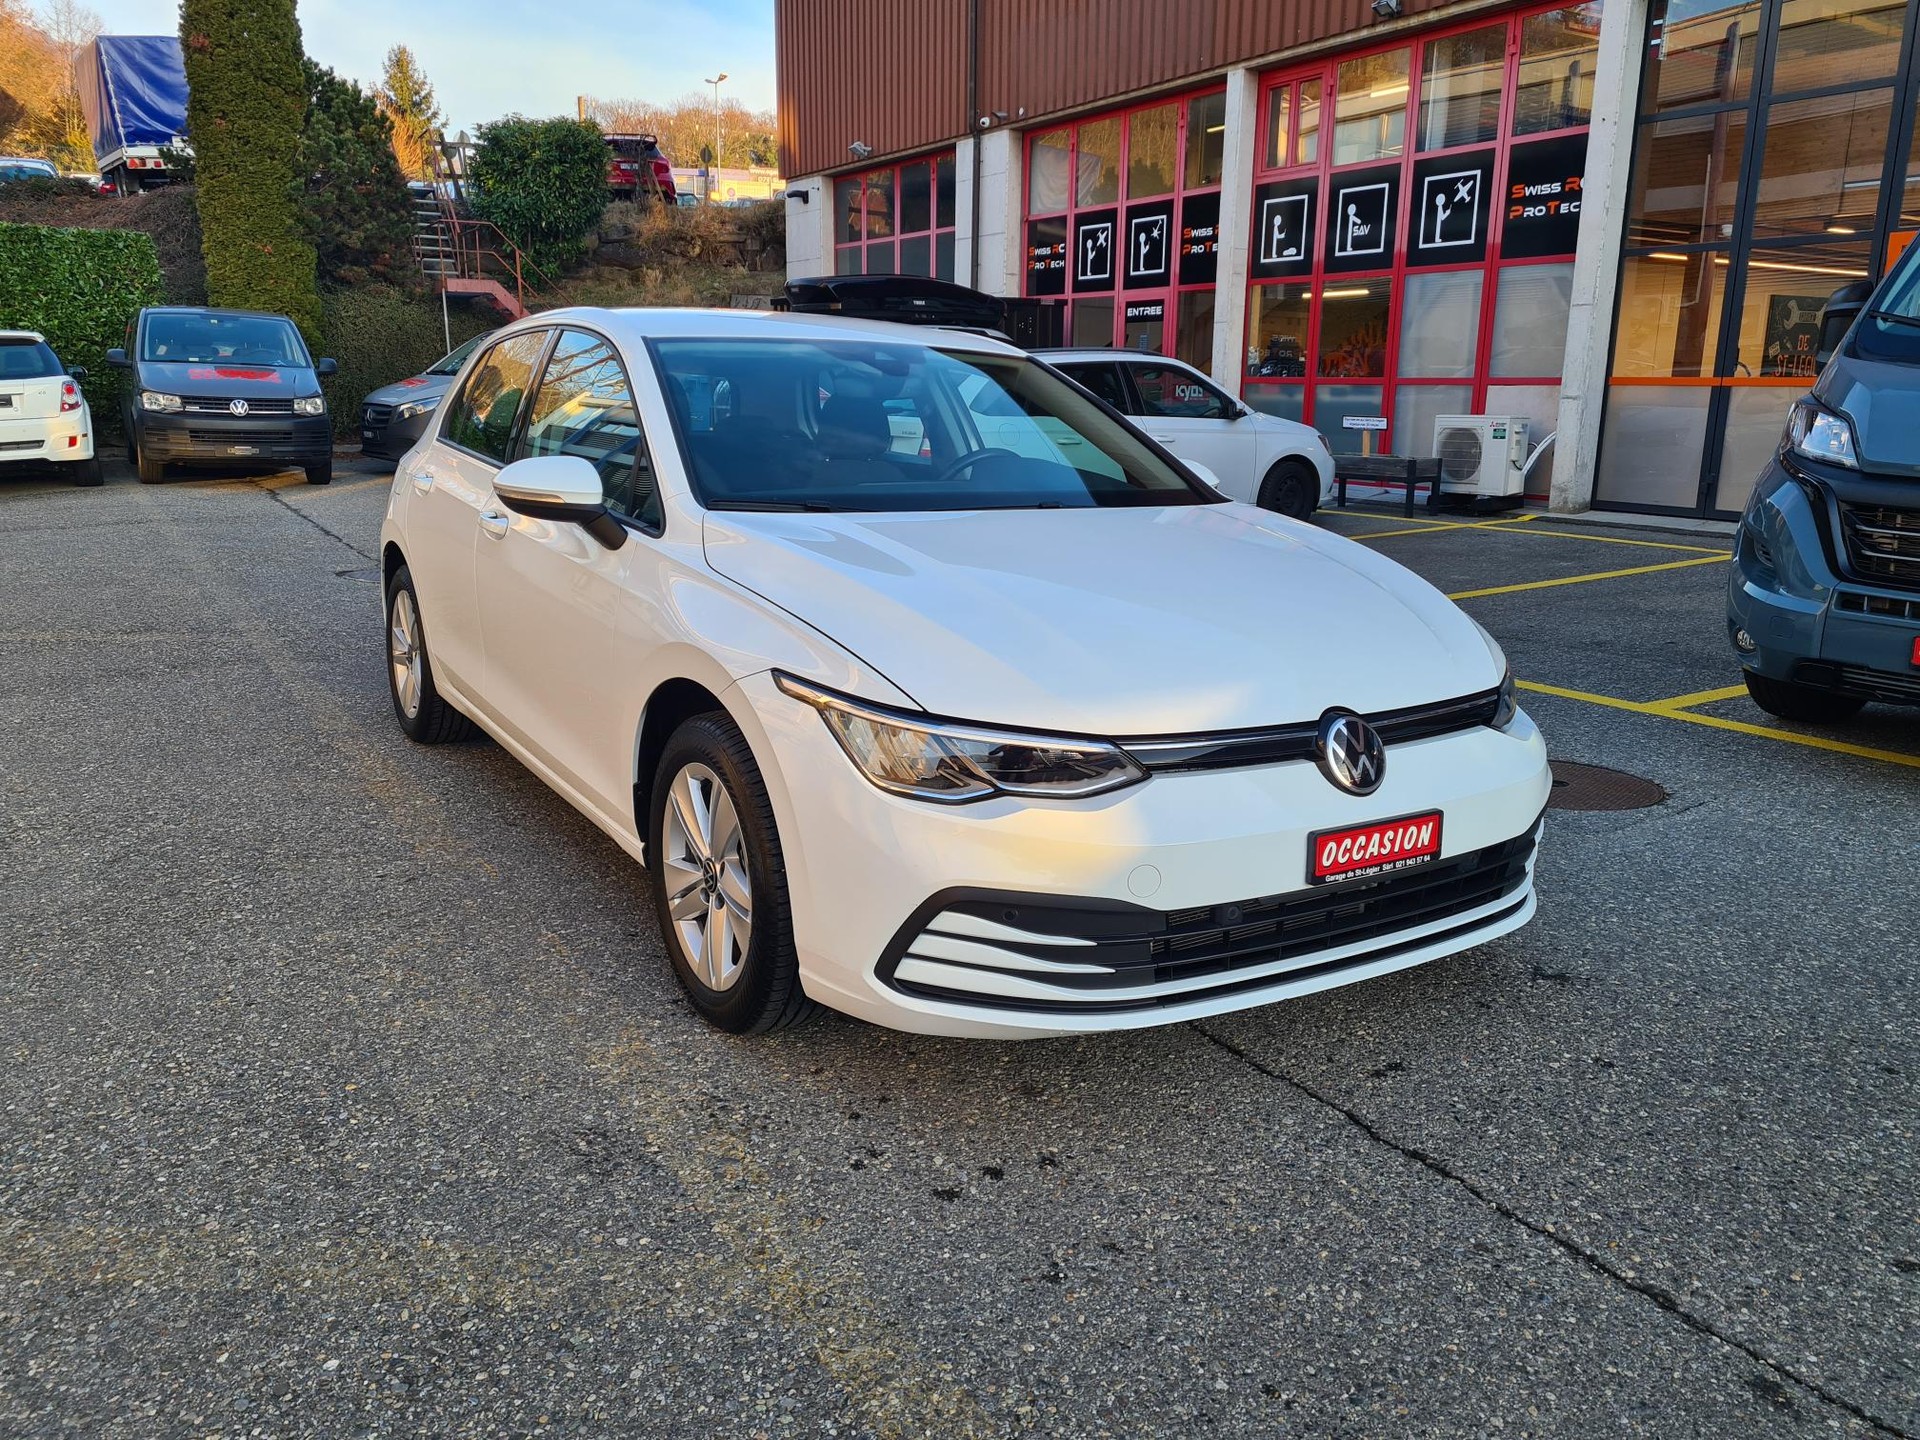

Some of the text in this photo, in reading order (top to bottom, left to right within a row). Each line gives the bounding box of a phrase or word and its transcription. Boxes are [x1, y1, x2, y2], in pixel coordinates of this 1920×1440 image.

[1511, 183, 1562, 198] SWISS
[1509, 201, 1581, 219] PROTEC
[1353, 224, 1371, 236] SAV
[1052, 243, 1065, 254] RC
[1183, 242, 1219, 255] PROTE
[1028, 259, 1065, 270] PROTECH
[1127, 306, 1163, 317] ENTREE
[1321, 821, 1434, 867] OCCASION
[1325, 874, 1346, 882] Garage
